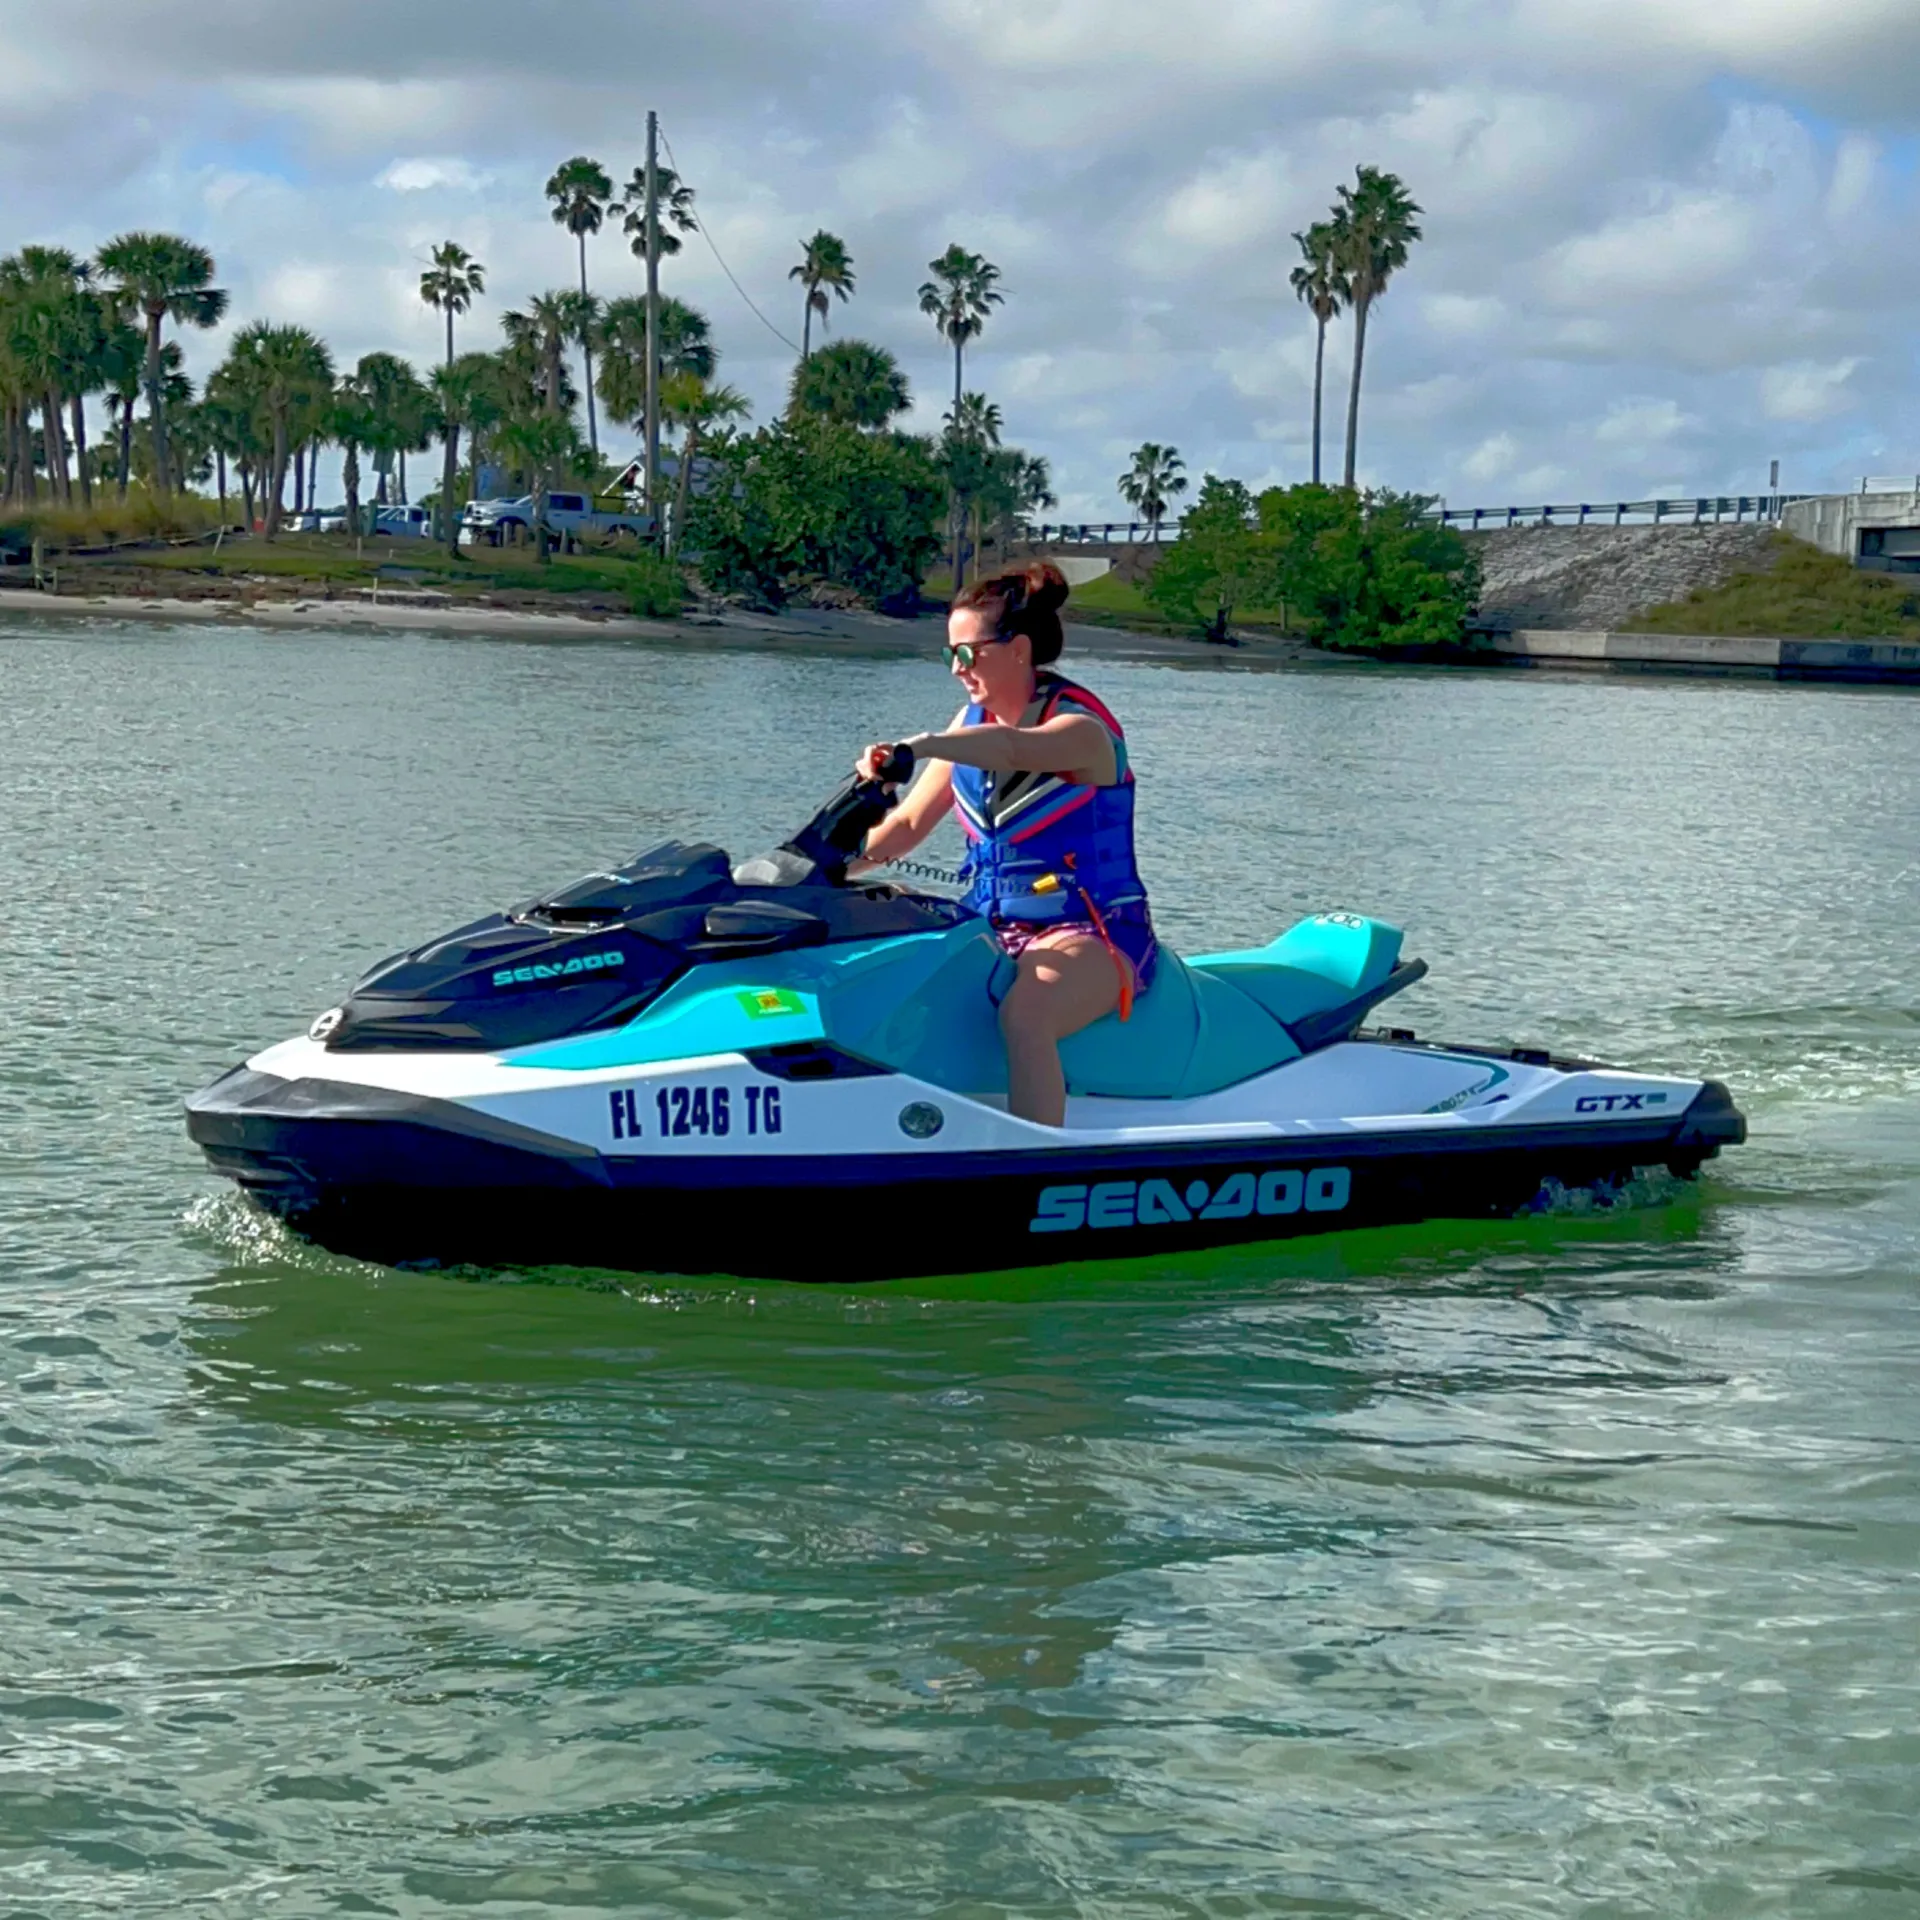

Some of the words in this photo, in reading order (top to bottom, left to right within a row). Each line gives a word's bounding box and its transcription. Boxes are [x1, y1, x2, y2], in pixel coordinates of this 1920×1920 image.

[609, 1088, 642, 1140] FL
[656, 1086, 730, 1137] 1246
[744, 1086, 782, 1135] TG
[1575, 1093, 1645, 1113] GTX
